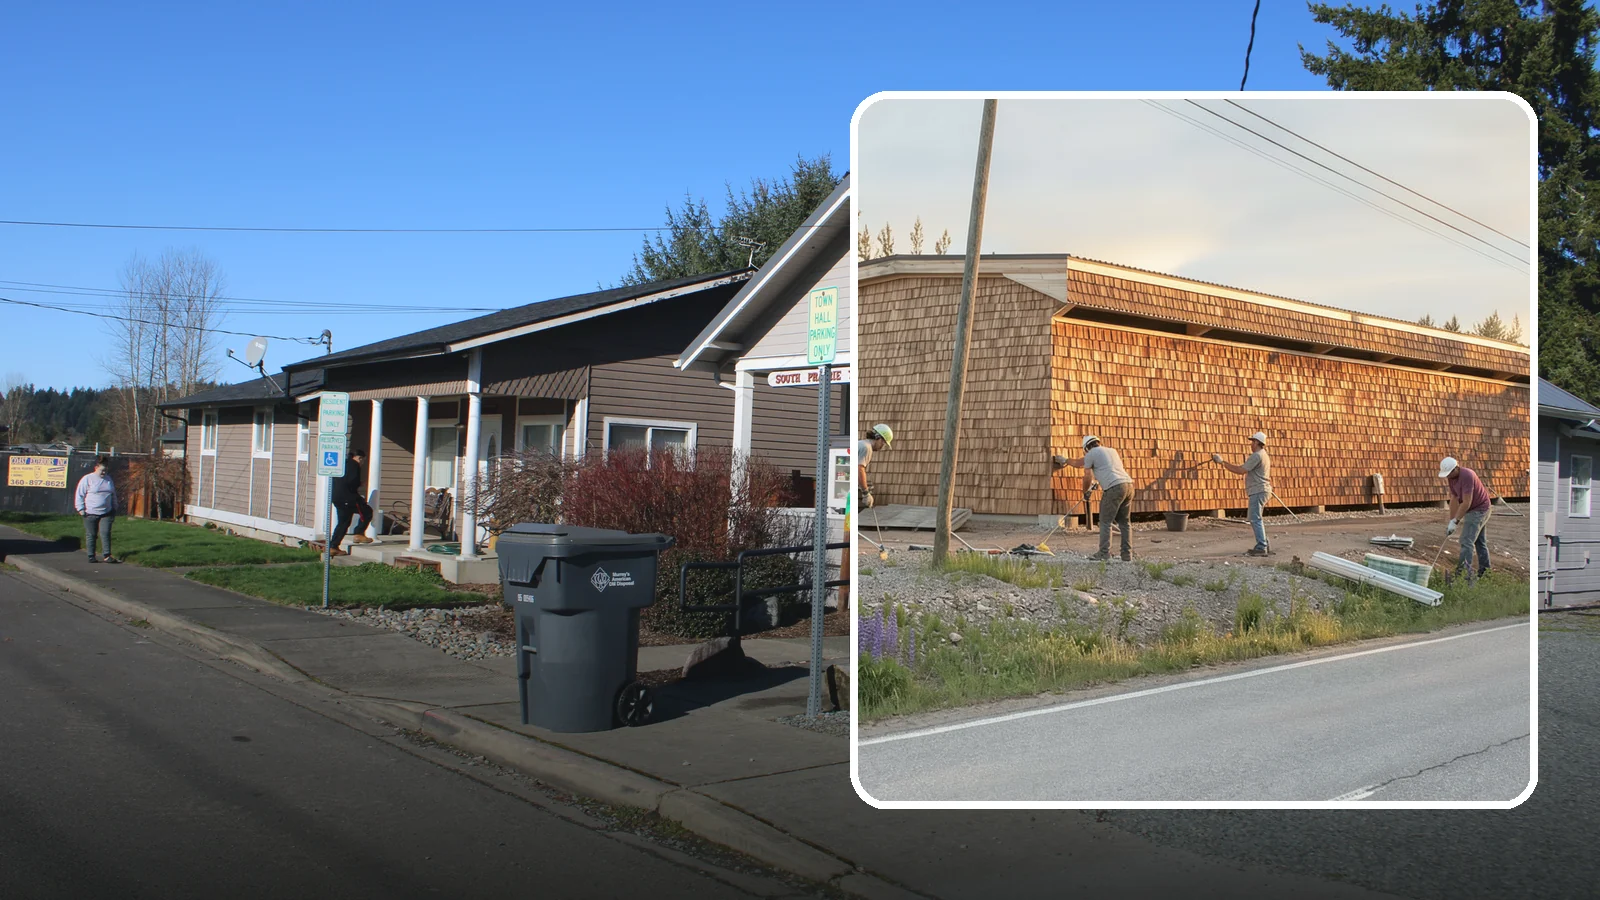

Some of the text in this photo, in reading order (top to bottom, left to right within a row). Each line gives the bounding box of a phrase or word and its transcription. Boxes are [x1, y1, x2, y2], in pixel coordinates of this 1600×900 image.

[815, 294, 833, 308] TOWN
[814, 312, 831, 324] HALL
[810, 326, 836, 340] PARKING
[814, 344, 831, 357] ONLY
[775, 373, 801, 384] SOUTH
[807, 370, 842, 382] PRIE
